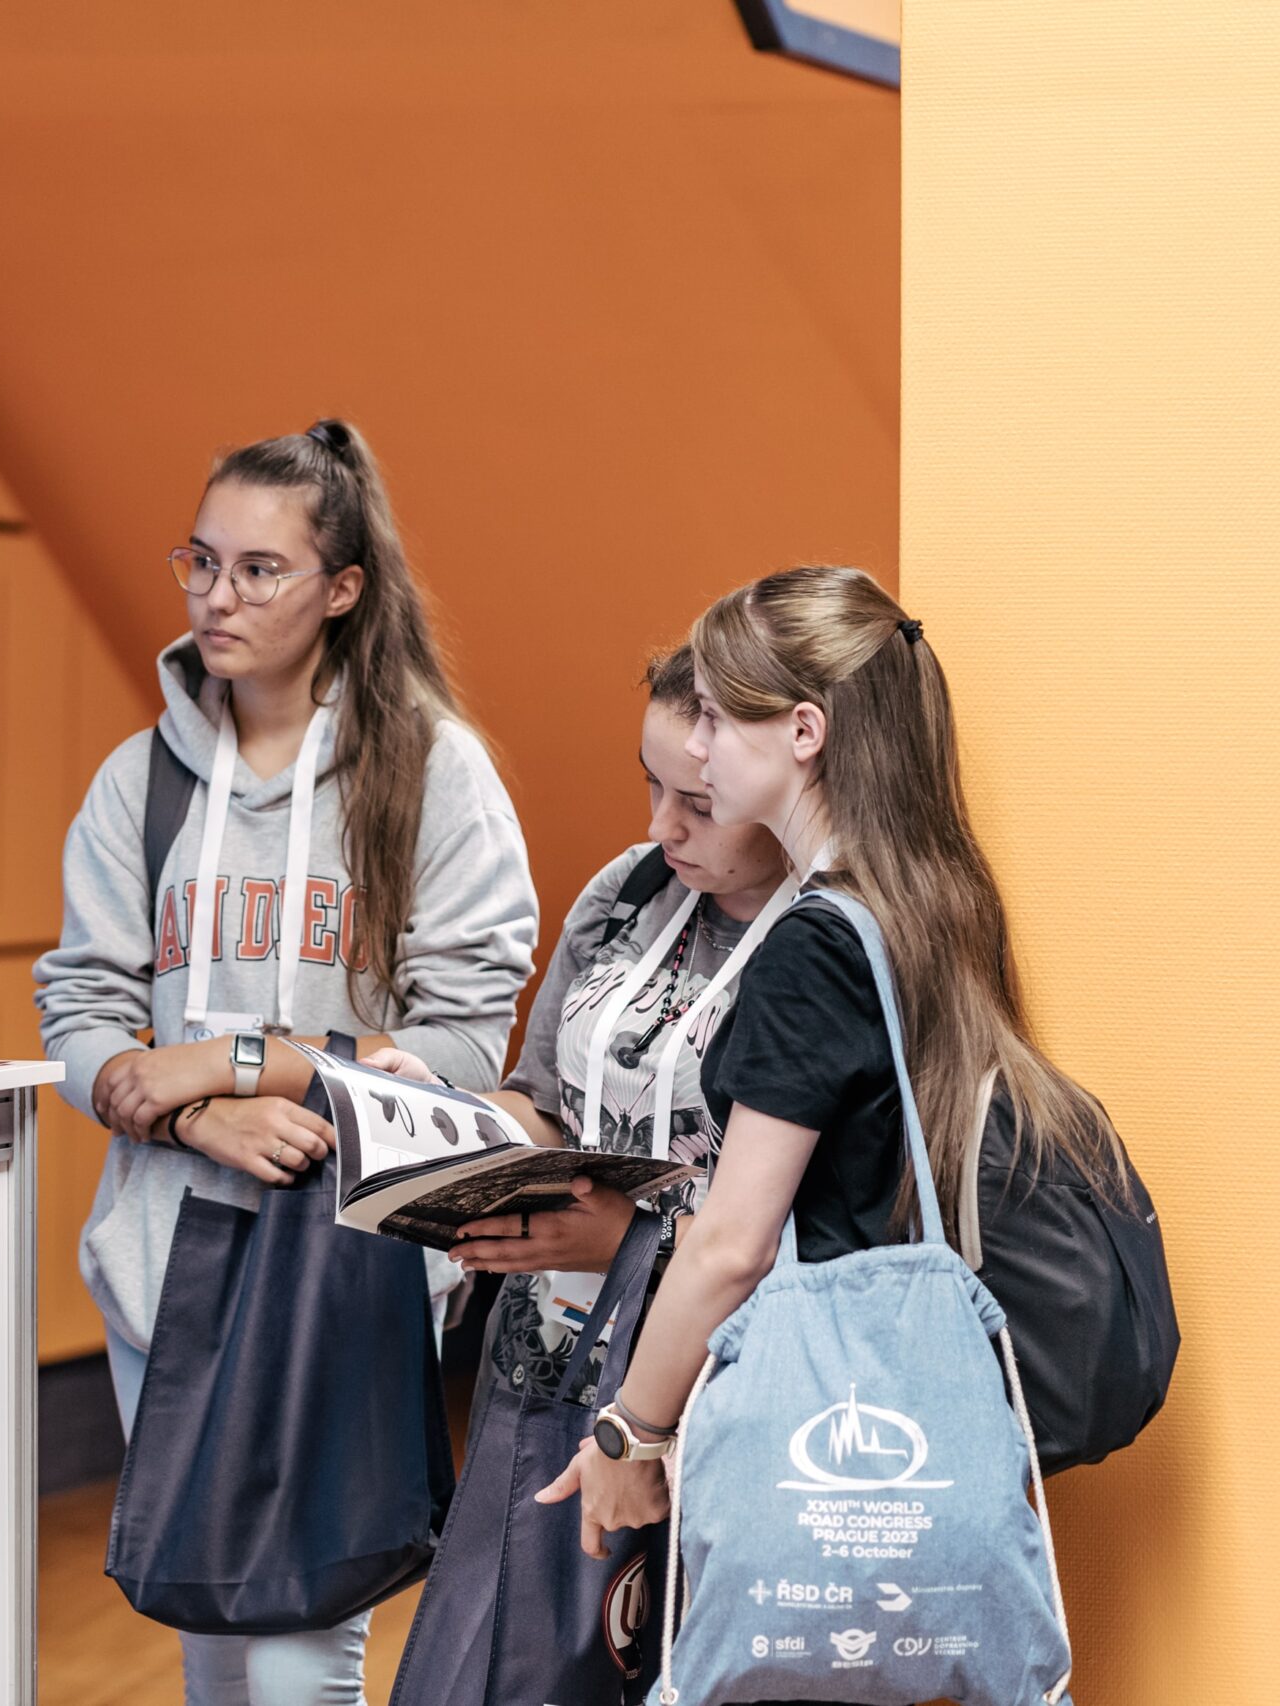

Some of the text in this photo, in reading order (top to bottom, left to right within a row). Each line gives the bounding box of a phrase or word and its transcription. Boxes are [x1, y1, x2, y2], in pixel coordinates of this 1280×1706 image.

[862, 1501, 925, 1515] WORLD
[797, 1512, 933, 1529] ROAD CONGRESS
[813, 1528, 918, 1543] PRAGUE 2023
[852, 1546, 913, 1559] October
[777, 1579, 853, 1603] ŘSD ČR
[775, 1636, 805, 1650] sfdi
